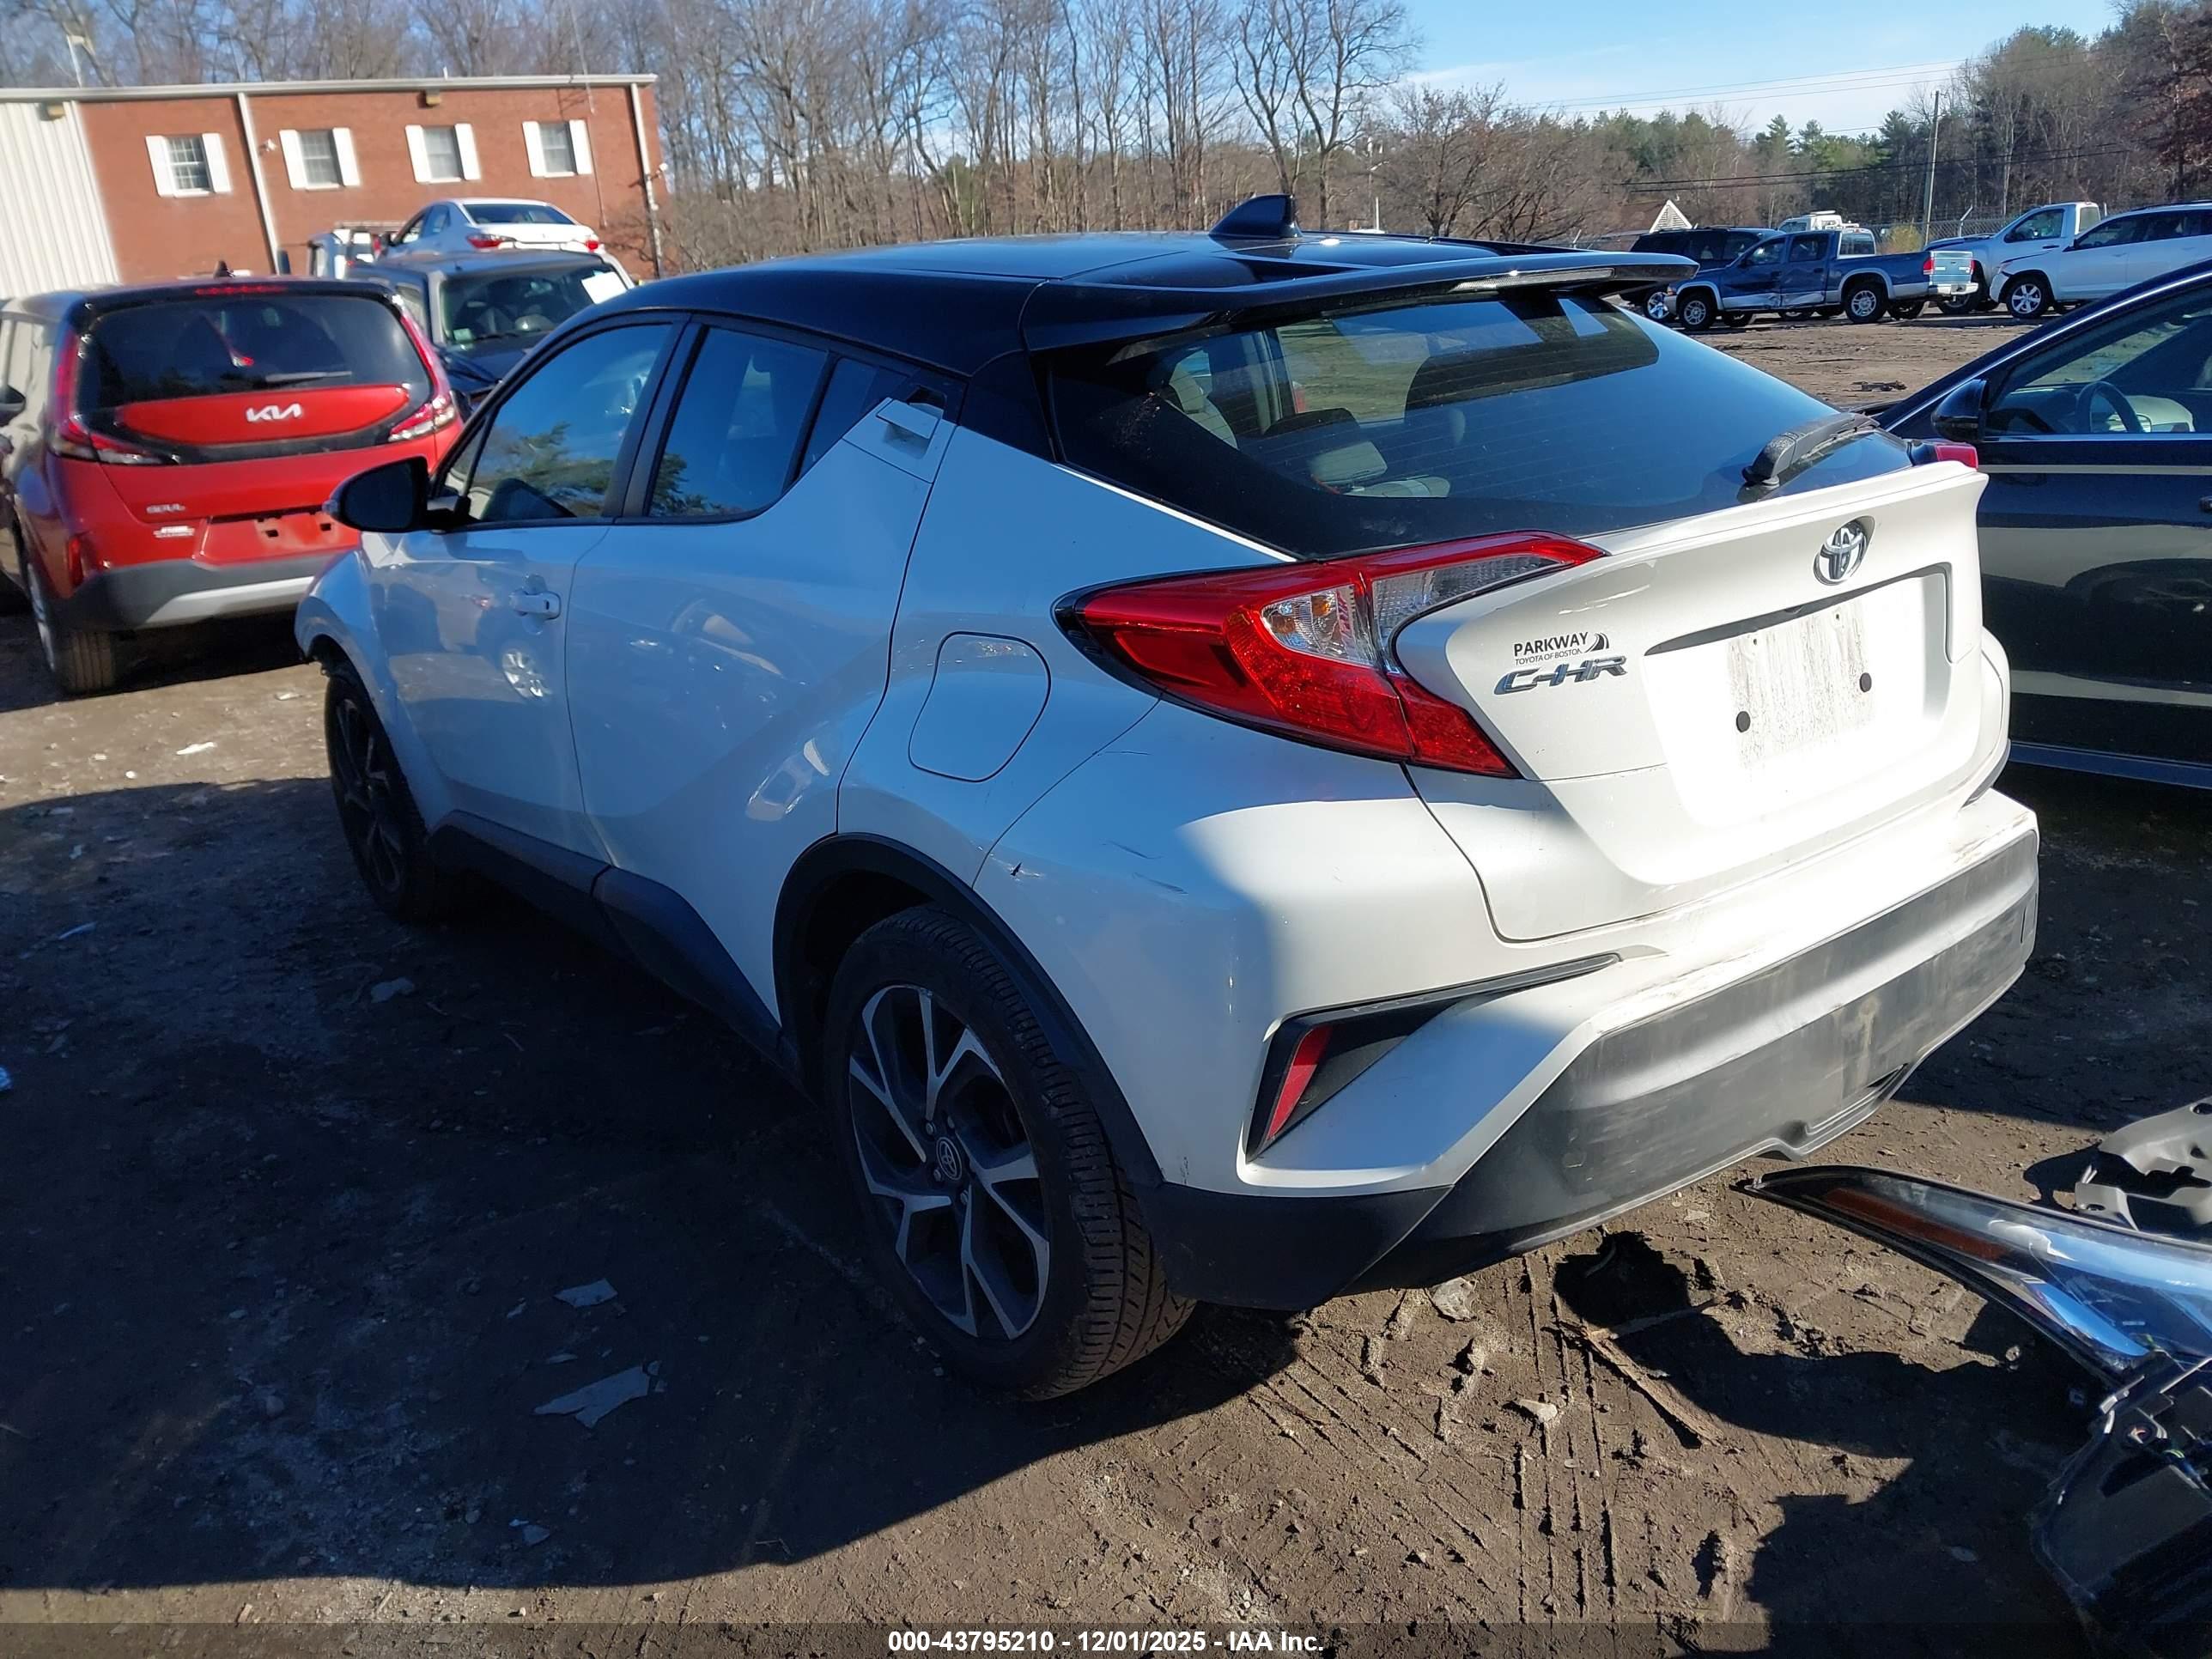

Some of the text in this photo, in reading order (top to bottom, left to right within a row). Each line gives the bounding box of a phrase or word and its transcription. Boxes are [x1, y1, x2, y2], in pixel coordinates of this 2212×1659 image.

[246, 403, 302, 422] KIA
[1514, 631, 1589, 657] PARKWAY
[1516, 654, 1543, 665] TOYOTA
[1493, 655, 1628, 696] C-HR
